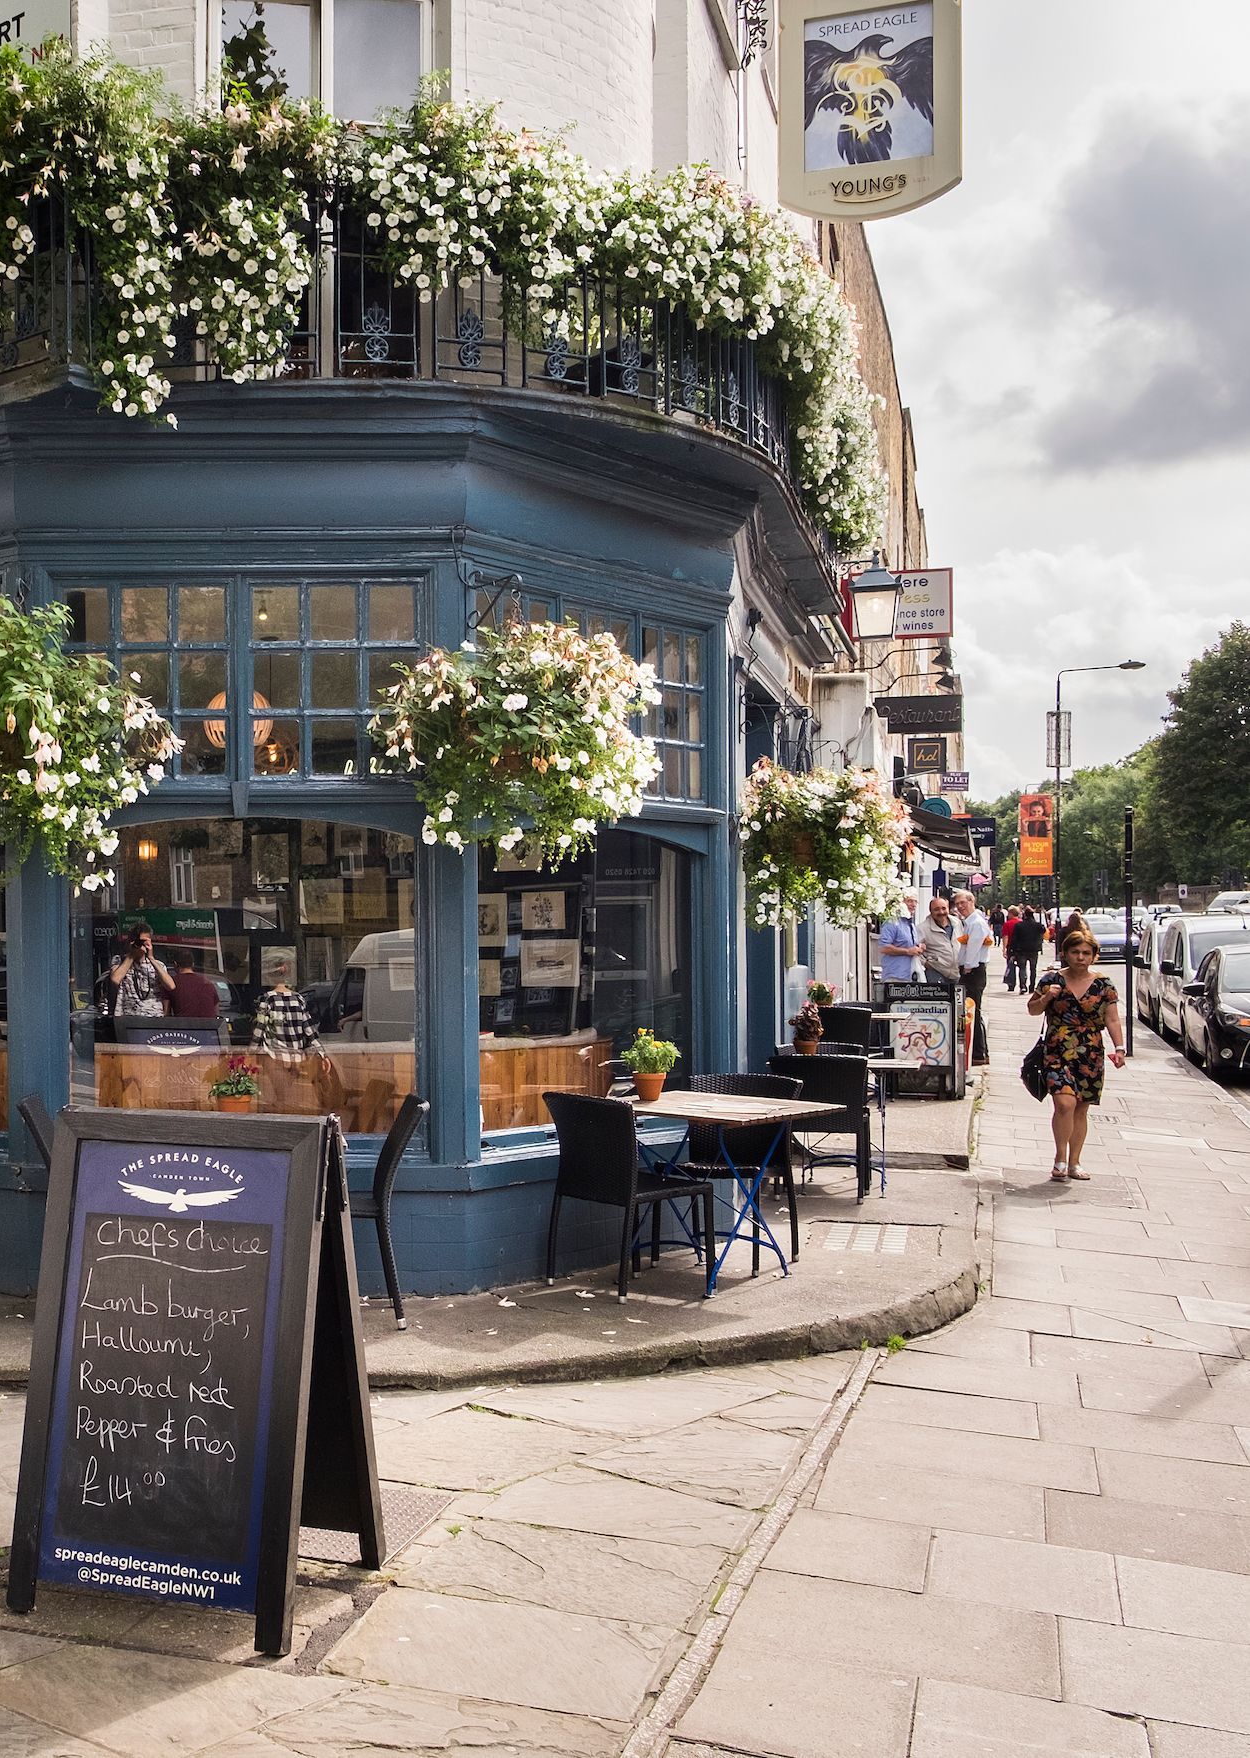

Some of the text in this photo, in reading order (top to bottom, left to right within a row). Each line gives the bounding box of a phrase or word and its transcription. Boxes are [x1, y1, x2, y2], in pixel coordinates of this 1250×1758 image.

[818, 11, 918, 38] SPREAD EAGLE
[830, 173, 908, 197] YOUNG'S
[902, 621, 934, 631] wines
[920, 608, 945, 618] store
[916, 748, 938, 761] hd
[889, 984, 905, 997] Time
[906, 984, 919, 997] Out
[121, 1152, 244, 1184] THE SPREAD EAGLE
[80, 1267, 249, 1342] Lamb burger,
[80, 1359, 179, 1399] Roasted
[155, 1409, 177, 1454] &
[54, 1547, 242, 1585] spreadeaglecamden.co.uk
[77, 1566, 216, 1600] @SpreadEagleNW1
